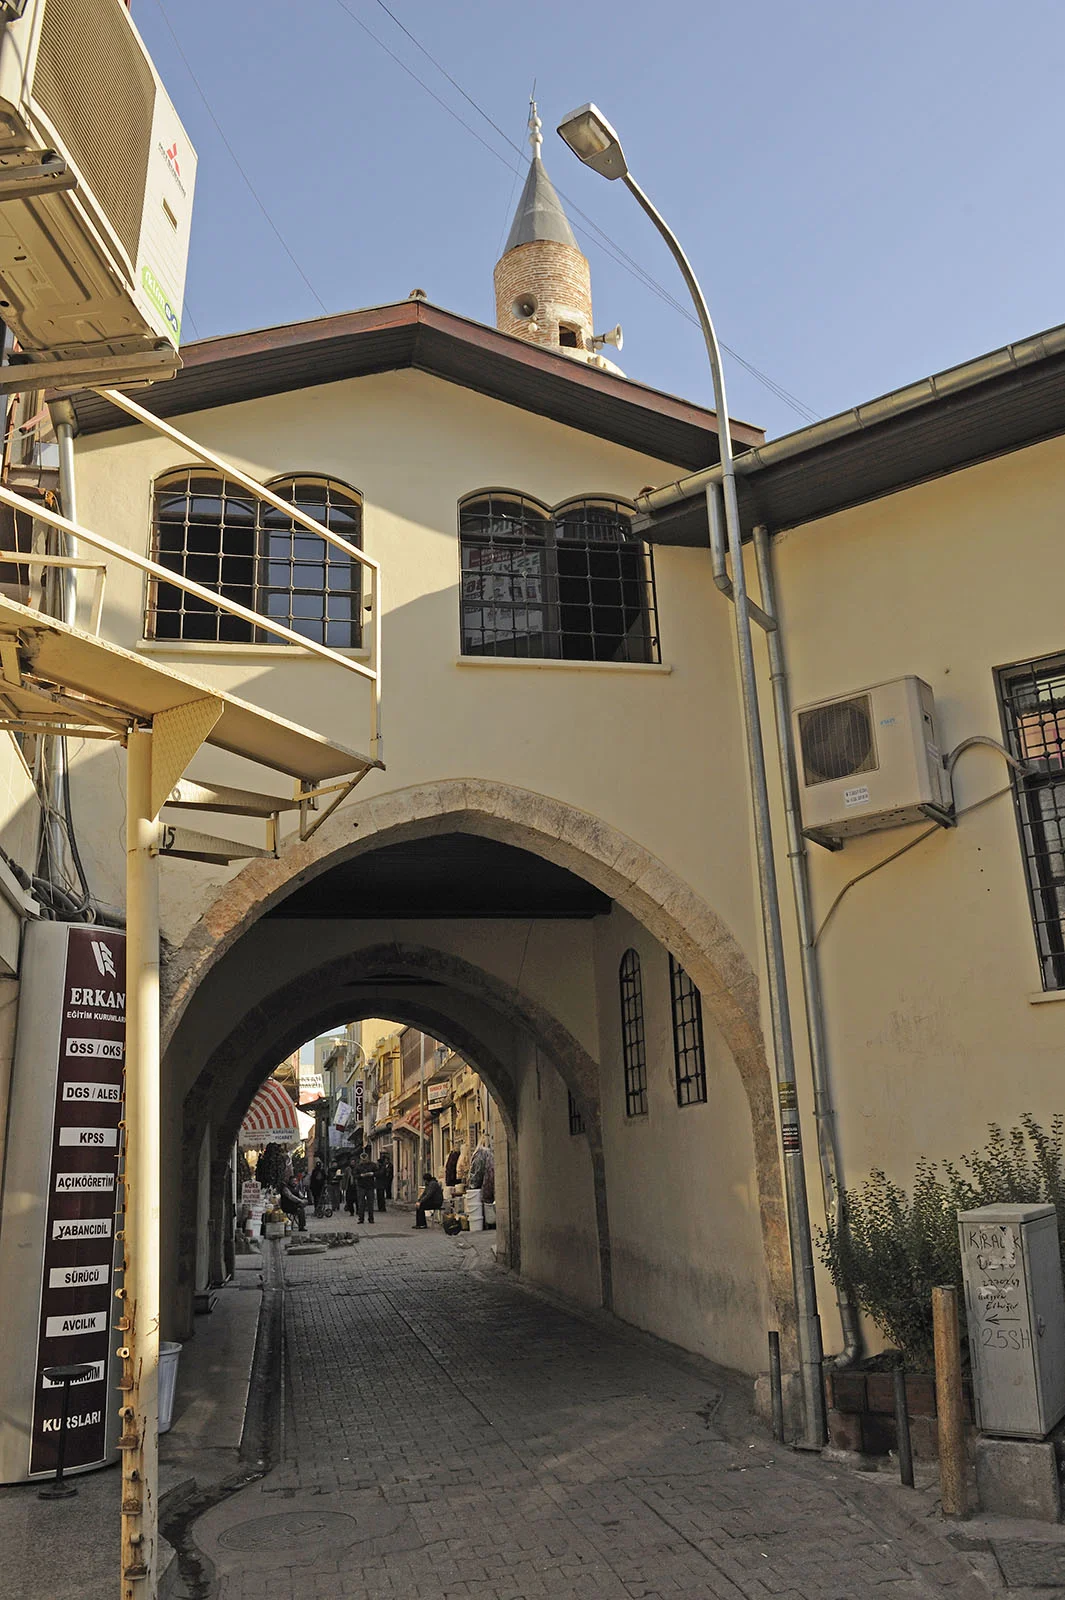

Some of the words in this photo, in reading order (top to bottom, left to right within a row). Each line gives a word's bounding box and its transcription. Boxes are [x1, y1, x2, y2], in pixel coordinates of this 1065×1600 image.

[162, 824, 176, 849] 15
[69, 987, 126, 1009] ERKAN
[66, 1010, 92, 1019] EĞİTİM
[93, 1013, 127, 1023] KURUMLAR
[69, 1040, 94, 1055] ÖSS
[96, 1044, 101, 1055] /
[102, 1045, 121, 1057] OKS
[66, 1087, 90, 1099] DGS
[92, 1088, 96, 1099] /
[97, 1088, 118, 1100] ALES
[355, 1086, 364, 1122] OTEL
[79, 1132, 104, 1144] KPSS
[57, 1175, 114, 1191] AÇIKÖĞRETİM
[64, 1269, 100, 1284] SÜRÜCÜ
[62, 1317, 97, 1332] AVCILIK
